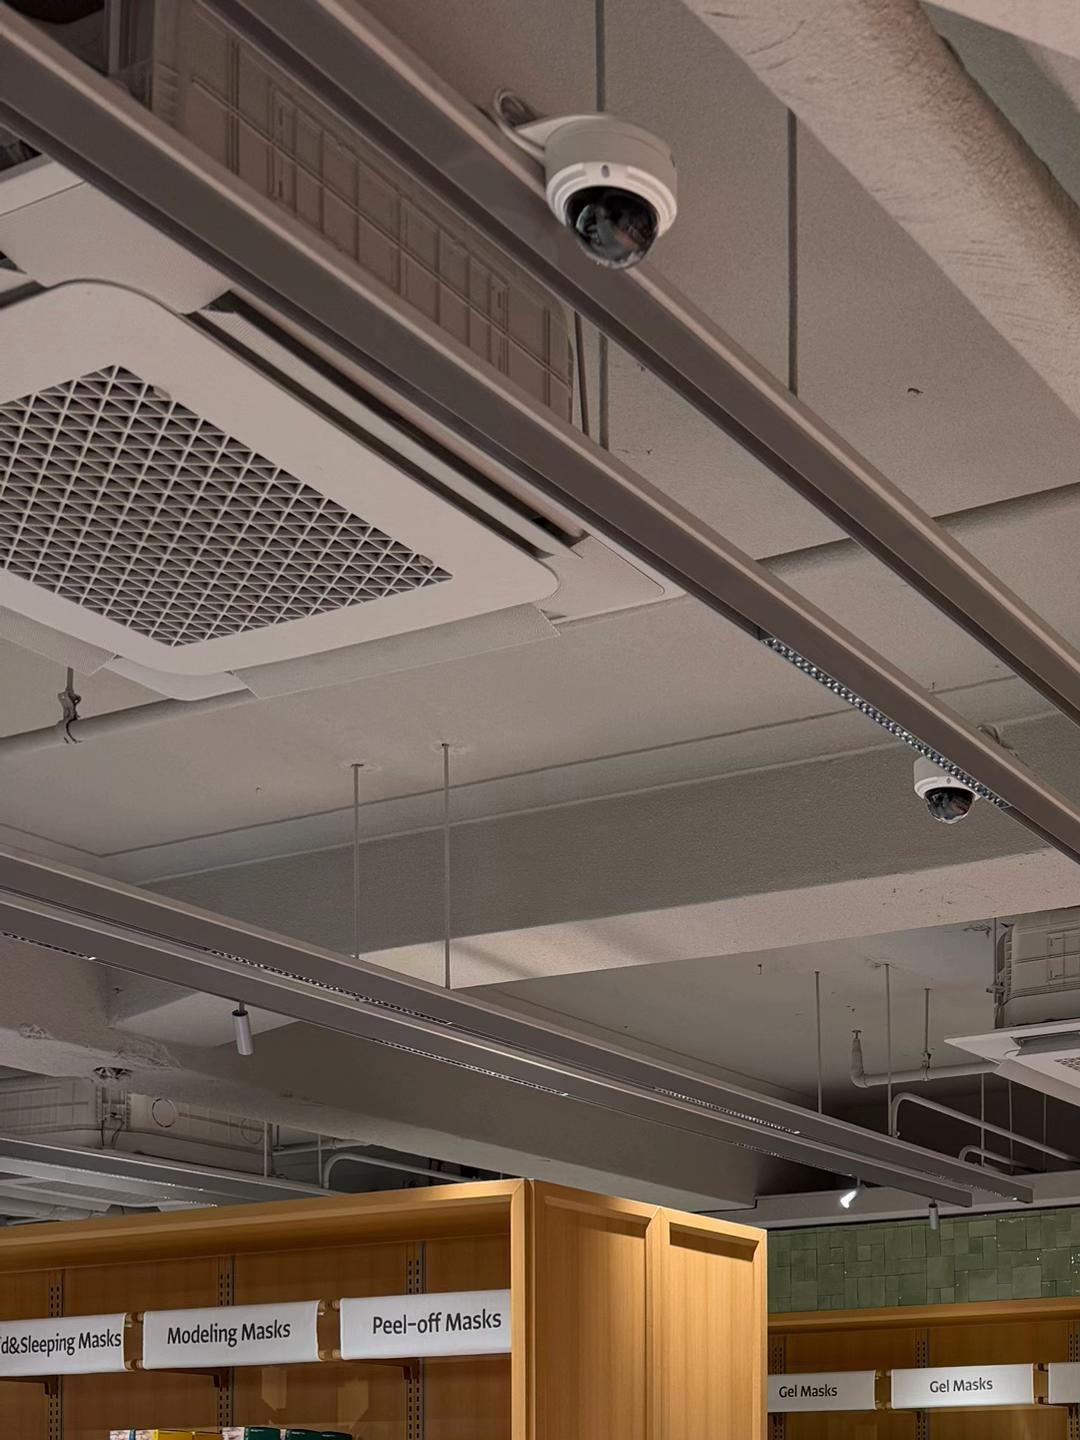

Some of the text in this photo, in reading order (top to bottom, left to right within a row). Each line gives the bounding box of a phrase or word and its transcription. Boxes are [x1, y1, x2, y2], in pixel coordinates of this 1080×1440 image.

[167, 1321, 291, 1347] Modeling Masks
[372, 1311, 502, 1334] Peel-off Masks
[0, 1328, 122, 1358] d&Sleeping Masks
[779, 1384, 838, 1398] Gel Masks
[930, 1378, 993, 1393] Gel Masks
